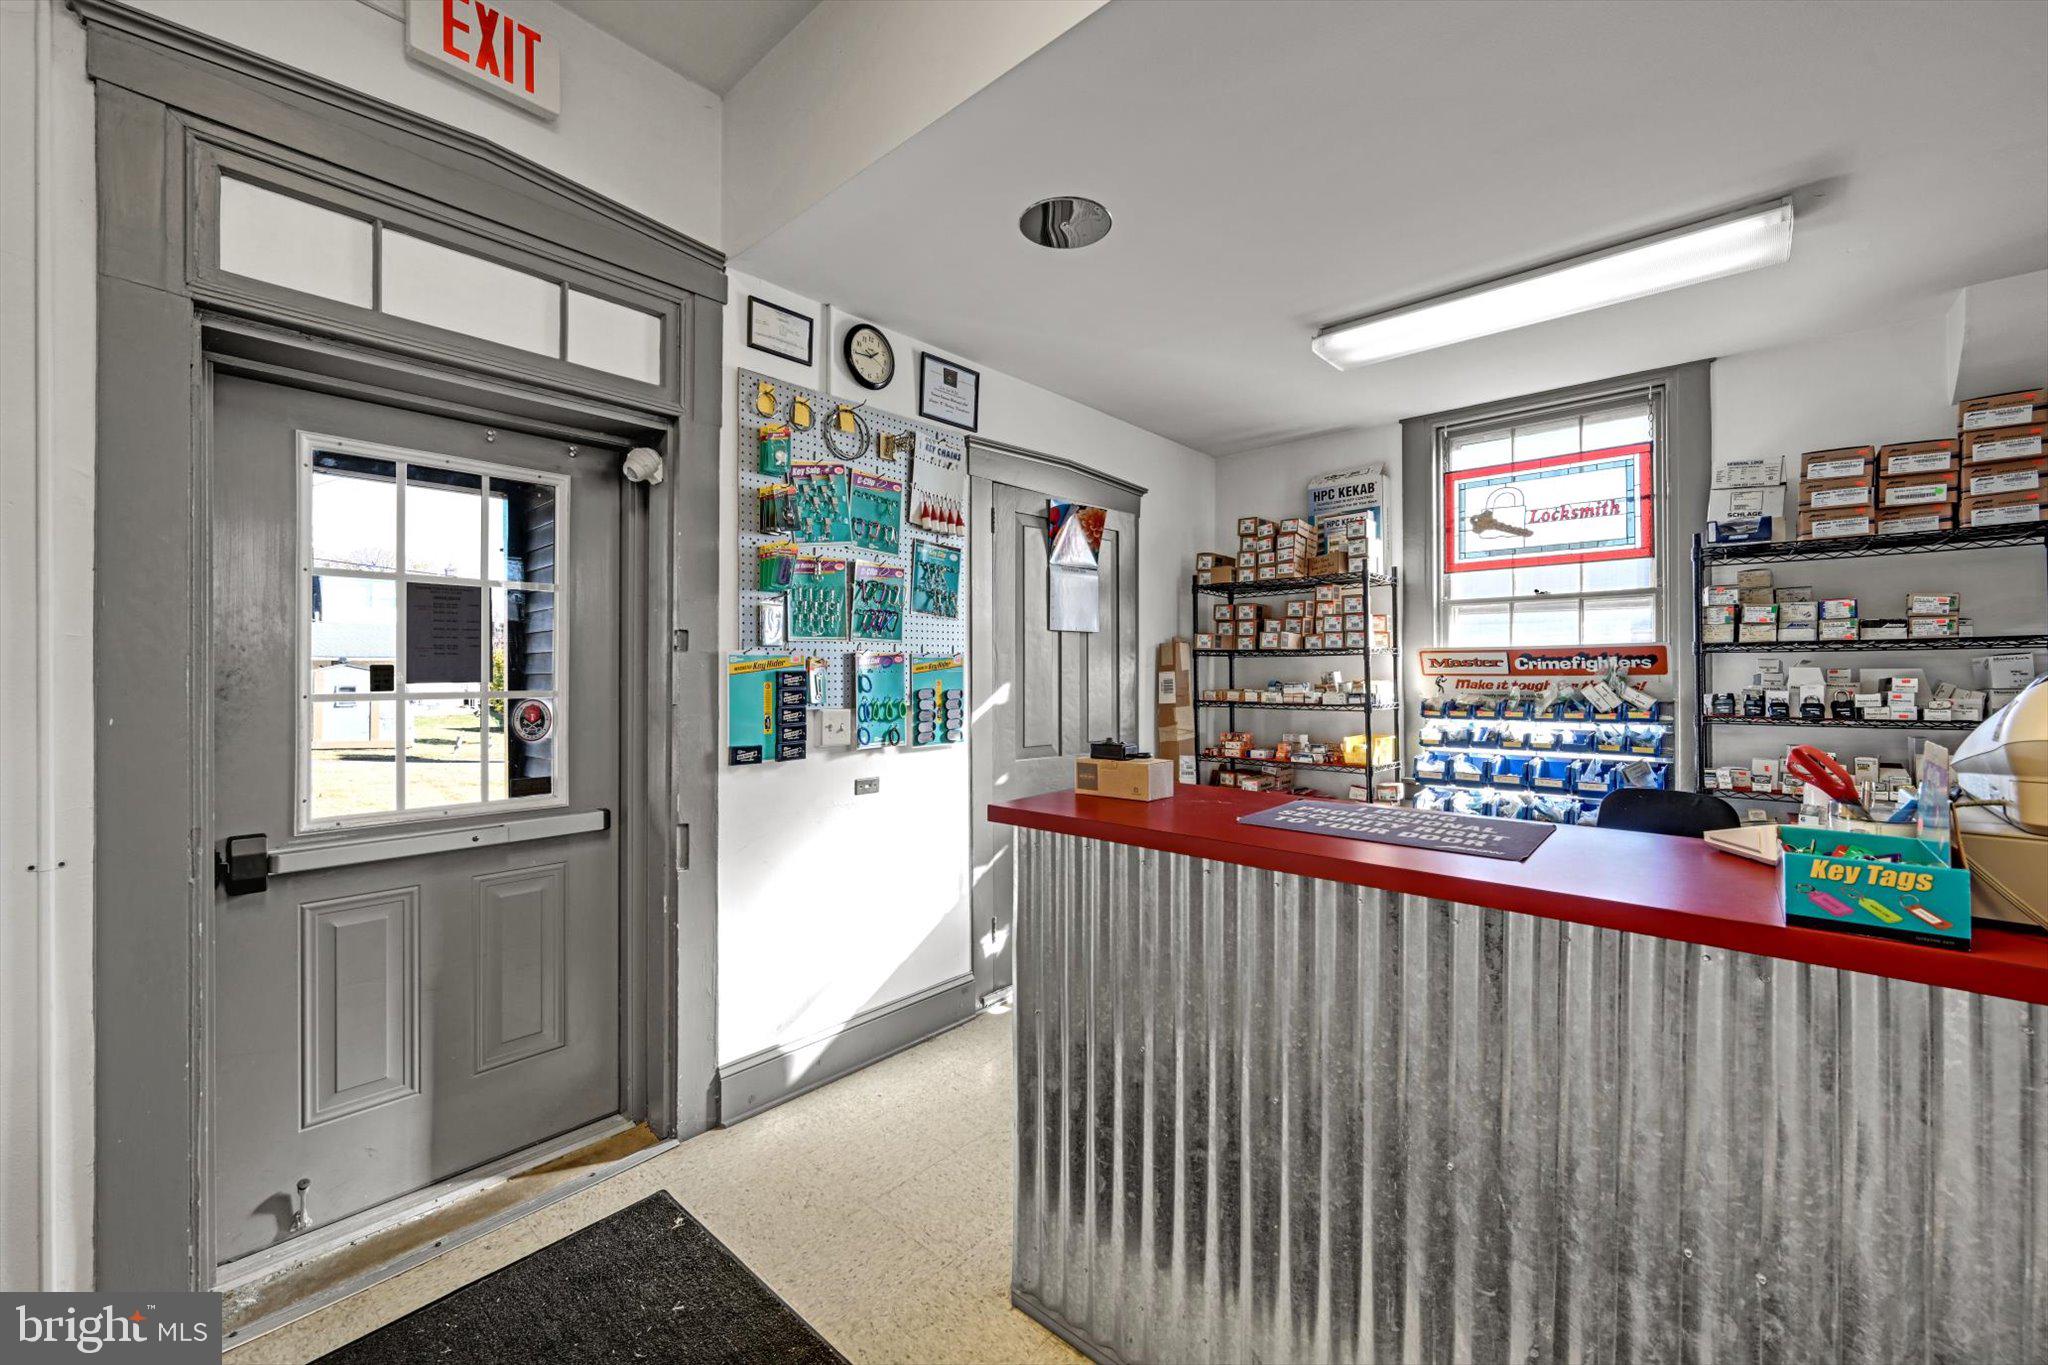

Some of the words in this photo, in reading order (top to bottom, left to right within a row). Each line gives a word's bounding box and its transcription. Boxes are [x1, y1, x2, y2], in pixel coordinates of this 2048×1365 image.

[443, 0, 541, 94] EXIT
[1313, 488, 1335, 502] HPC
[1338, 482, 1375, 499] KEKAB
[1528, 499, 1620, 524] Locksmith
[1326, 520, 1340, 528] HPC
[752, 661, 766, 671] Key
[766, 659, 786, 668] Hider
[1428, 658, 1504, 669] Master
[1515, 655, 1652, 672] Crimefighters
[1455, 679, 1490, 690] Make
[1495, 680, 1508, 690] it
[1278, 810, 1407, 829] SECURITY
[1414, 826, 1510, 841] RIGHT
[1297, 805, 1498, 834] PROFESSIONAL
[1374, 809, 1457, 822] BRING
[1274, 815, 1308, 824] TO
[1316, 821, 1390, 835] YOUR
[1398, 831, 1486, 847] DOOR
[1810, 858, 1861, 885] Key
[1867, 864, 1935, 892] Tags
